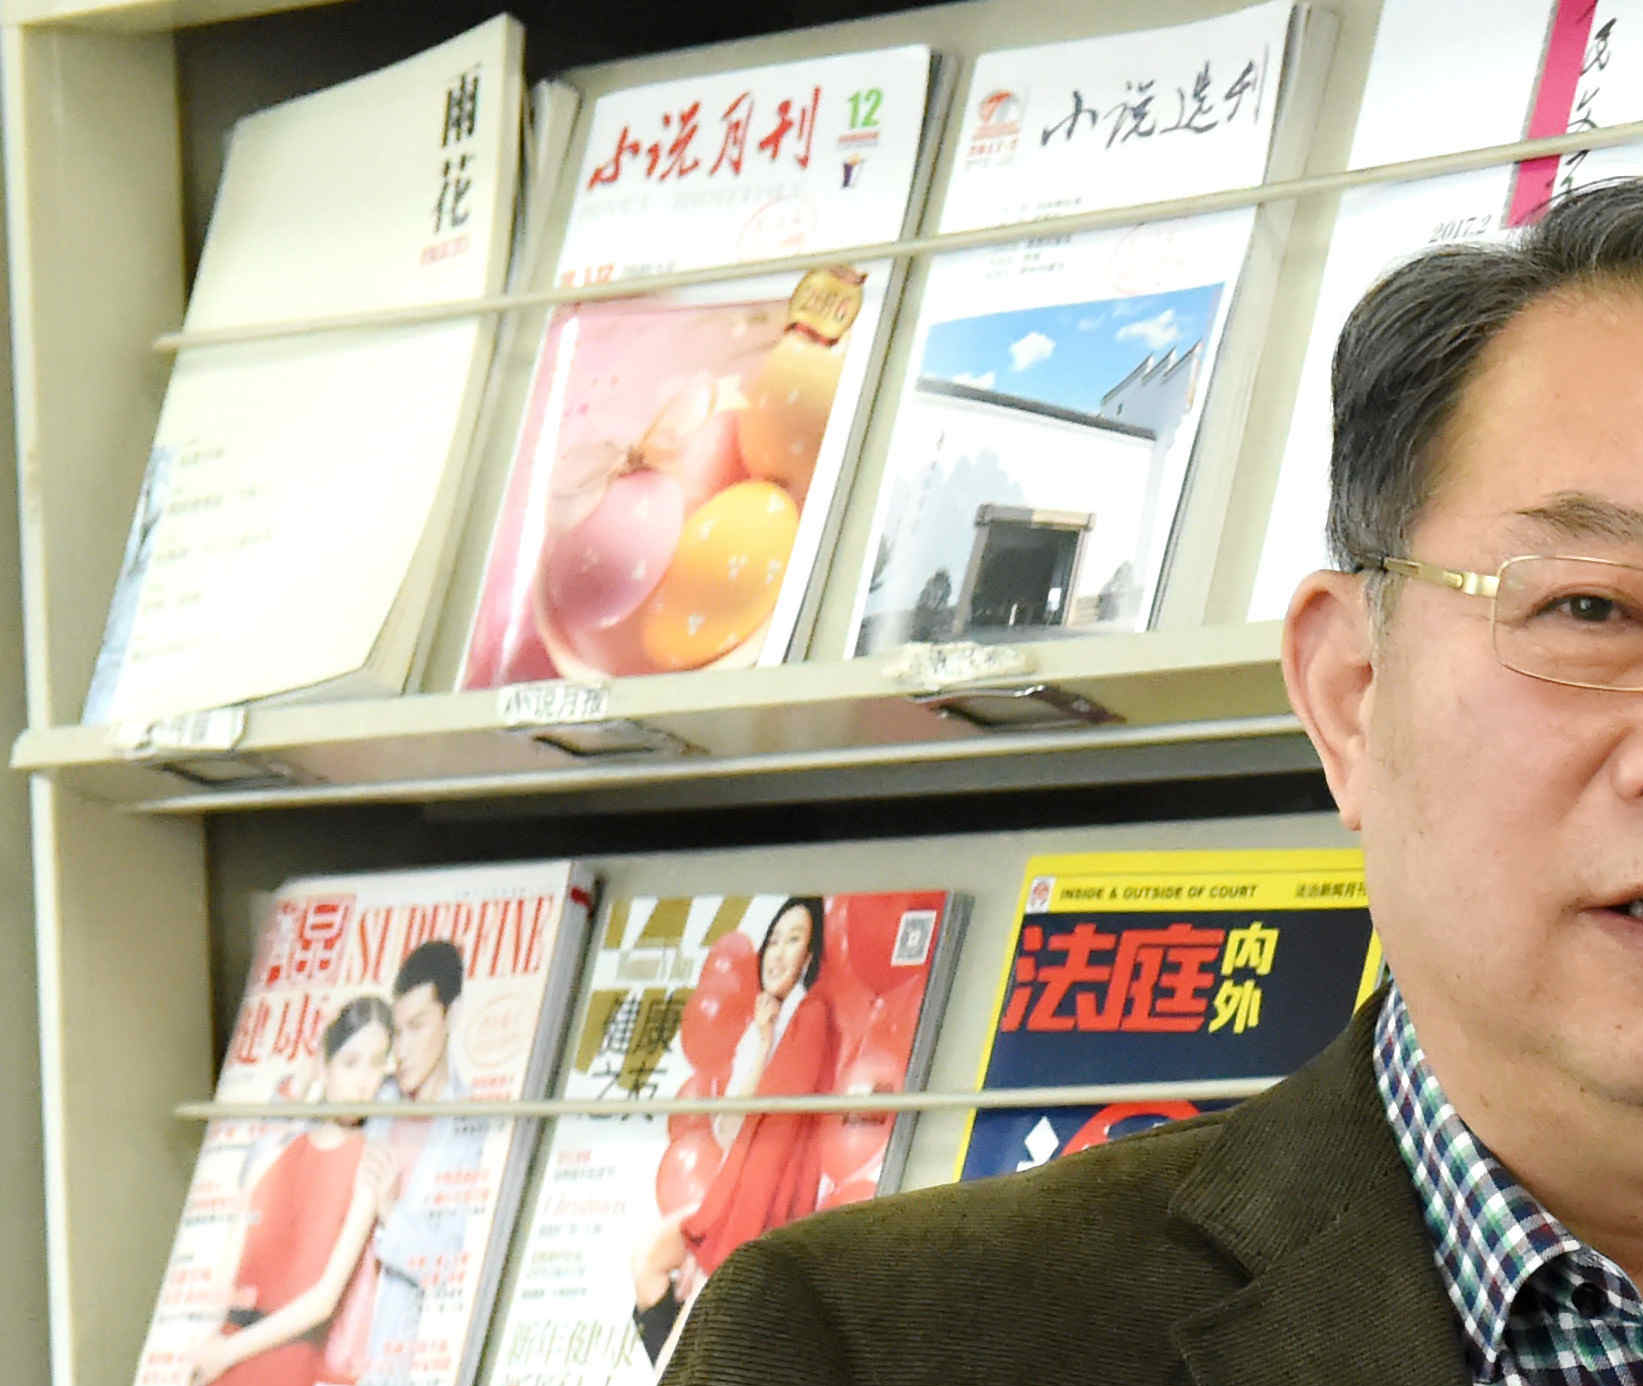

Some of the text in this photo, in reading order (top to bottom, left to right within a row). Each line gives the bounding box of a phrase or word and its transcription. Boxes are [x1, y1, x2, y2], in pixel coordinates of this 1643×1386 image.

[430, 66, 483, 236] 雨花
[586, 86, 823, 192] 小说月刊
[846, 88, 885, 129] 12
[1060, 887, 1104, 901] INSIDE
[1123, 886, 1182, 900] OUTSIDE
[1188, 886, 1204, 899] OF
[1209, 885, 1257, 899] COURT
[1001, 920, 1279, 1036] 法庭 内外
